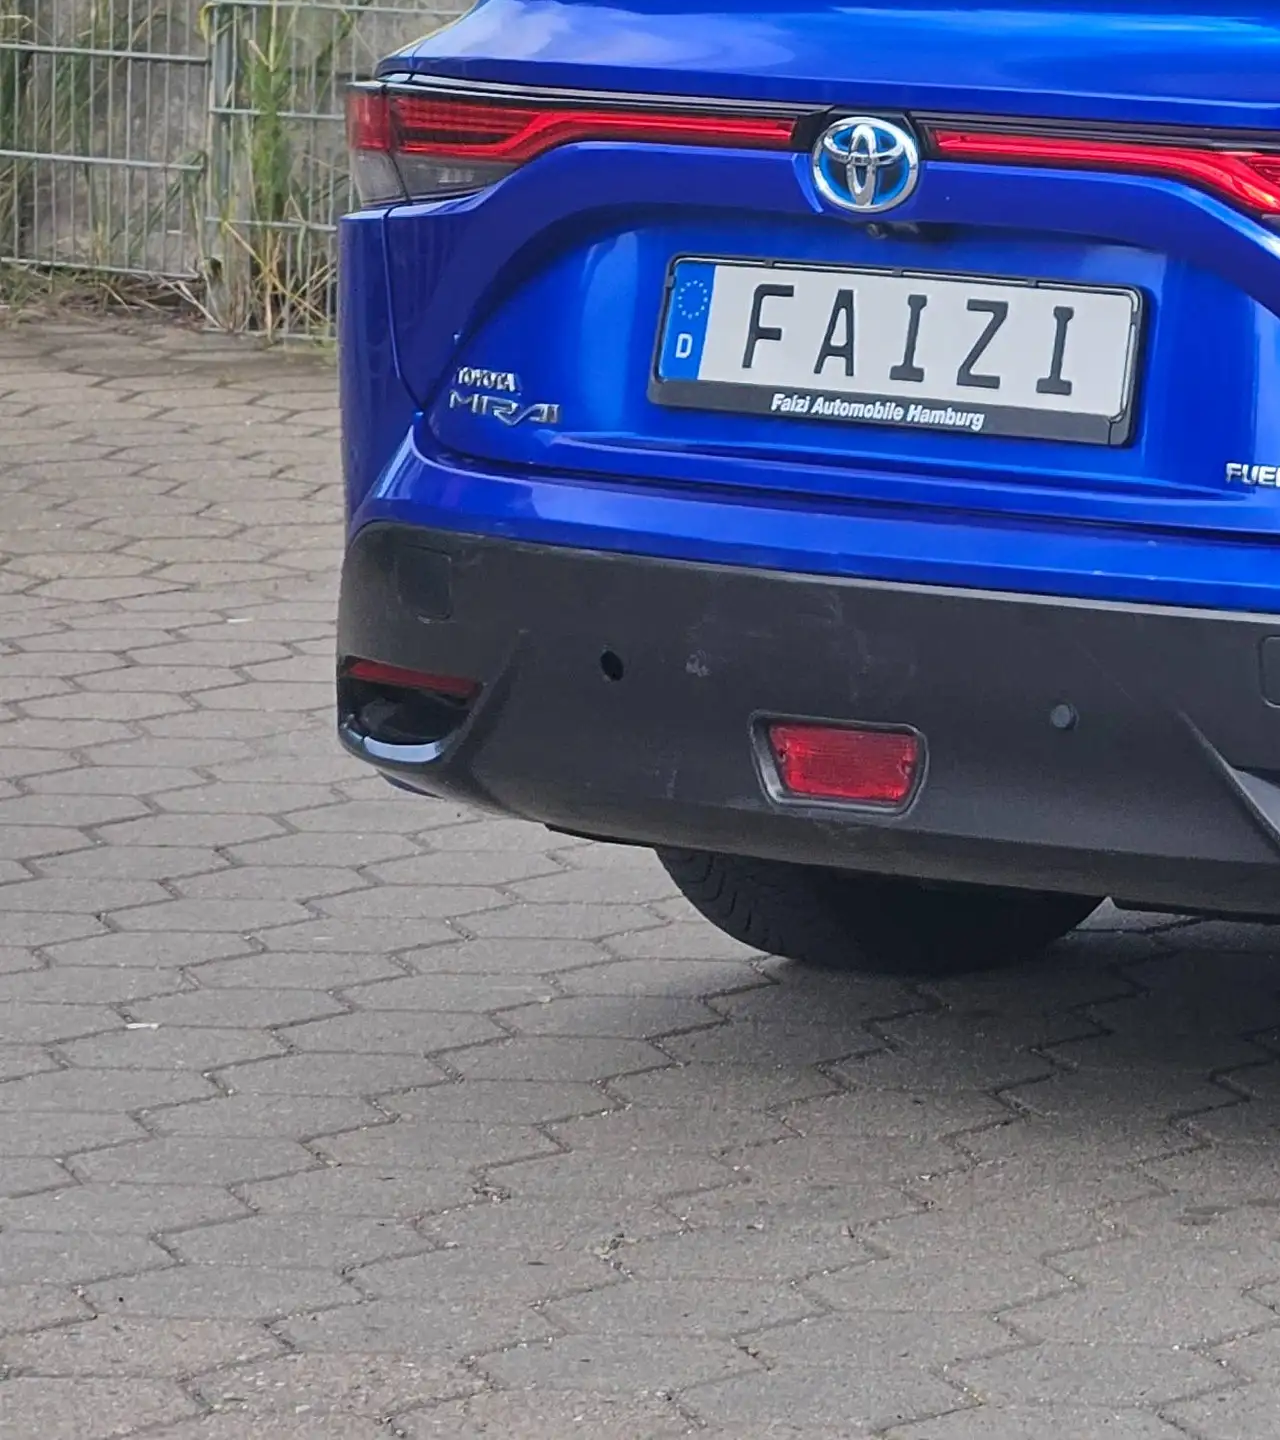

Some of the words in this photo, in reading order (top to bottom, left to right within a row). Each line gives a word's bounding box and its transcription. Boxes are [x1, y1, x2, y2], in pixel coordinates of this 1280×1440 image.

[676, 333, 692, 359] D
[742, 283, 1074, 395] FAIZI
[771, 392, 809, 414] Faizi
[811, 397, 904, 423] Automobile
[906, 403, 985, 430] Hamburg
